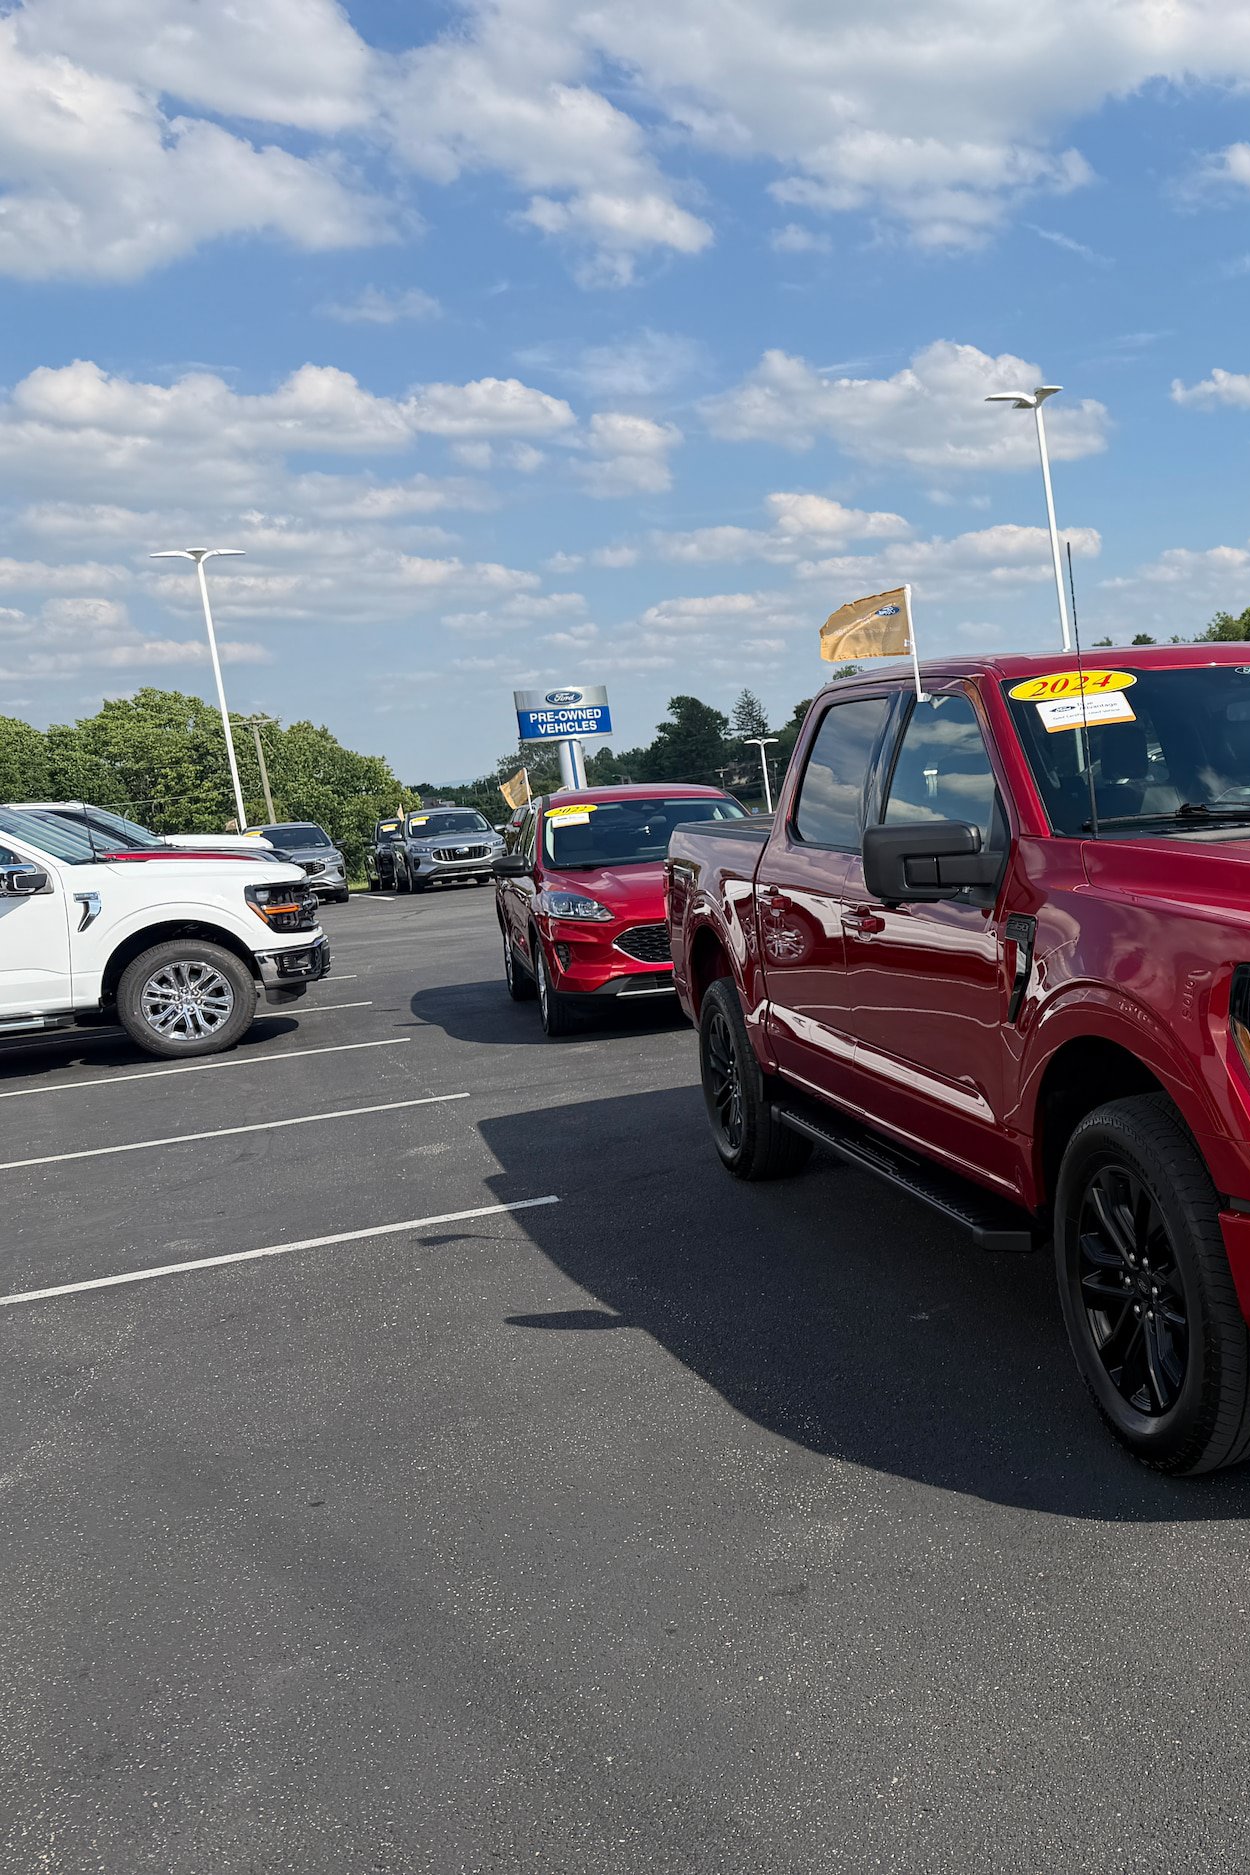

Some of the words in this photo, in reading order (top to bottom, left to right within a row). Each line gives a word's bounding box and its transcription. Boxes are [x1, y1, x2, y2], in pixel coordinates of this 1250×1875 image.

[1028, 673, 1113, 698] 2024
[554, 692, 576, 702] Ford
[529, 708, 602, 723] PRE-OWNED
[538, 720, 597, 734] VEHICLES
